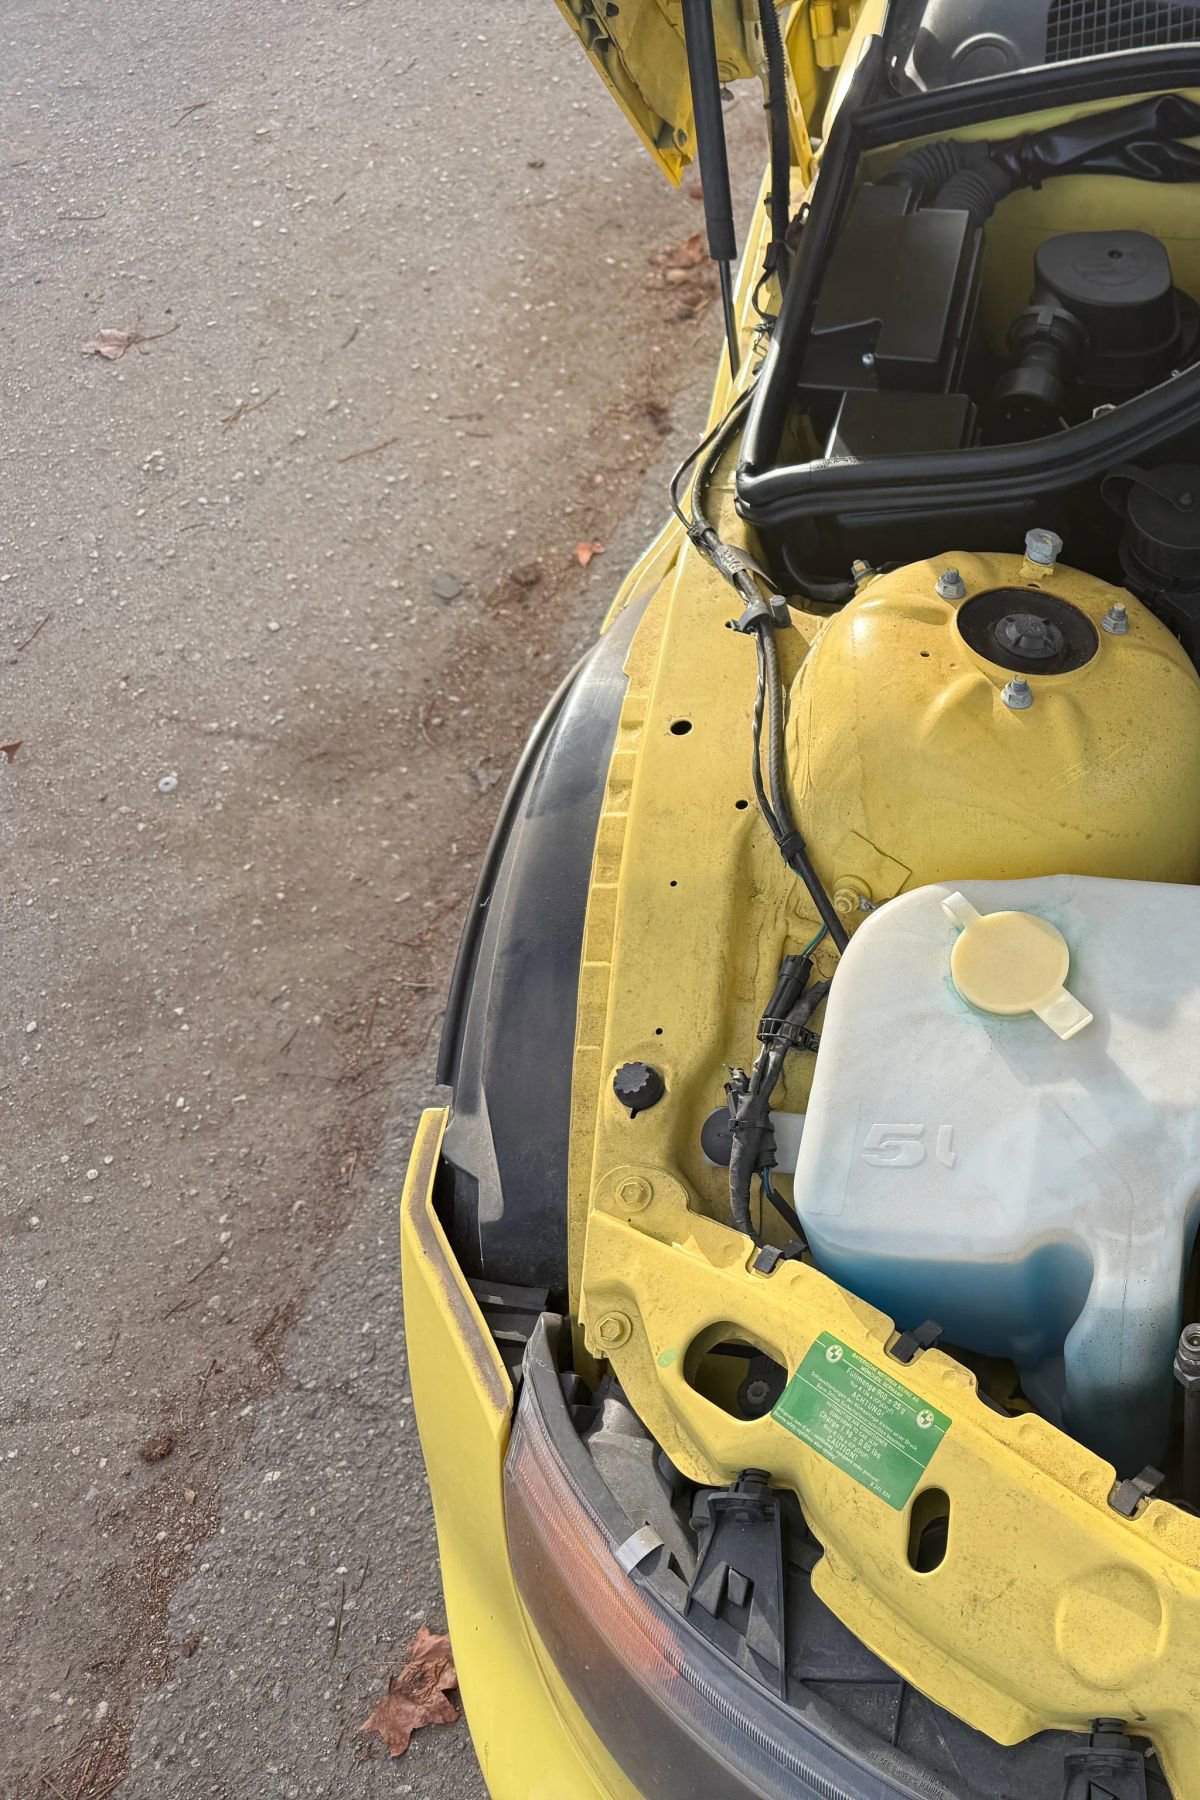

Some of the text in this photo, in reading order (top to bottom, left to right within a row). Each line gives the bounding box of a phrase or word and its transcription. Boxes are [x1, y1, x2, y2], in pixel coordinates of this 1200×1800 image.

[844, 1366, 877, 1394] Füllmenge
[875, 1388, 888, 1401] 900
[891, 1399, 902, 1410] 25
[899, 1407, 906, 1415] g
[850, 1389, 885, 1418] ACHTUNG!
[911, 1394, 920, 1403] AG
[817, 1409, 841, 1431] Charge
[870, 1446, 883, 1459] lbs
[825, 1433, 858, 1461] CAUTION!
